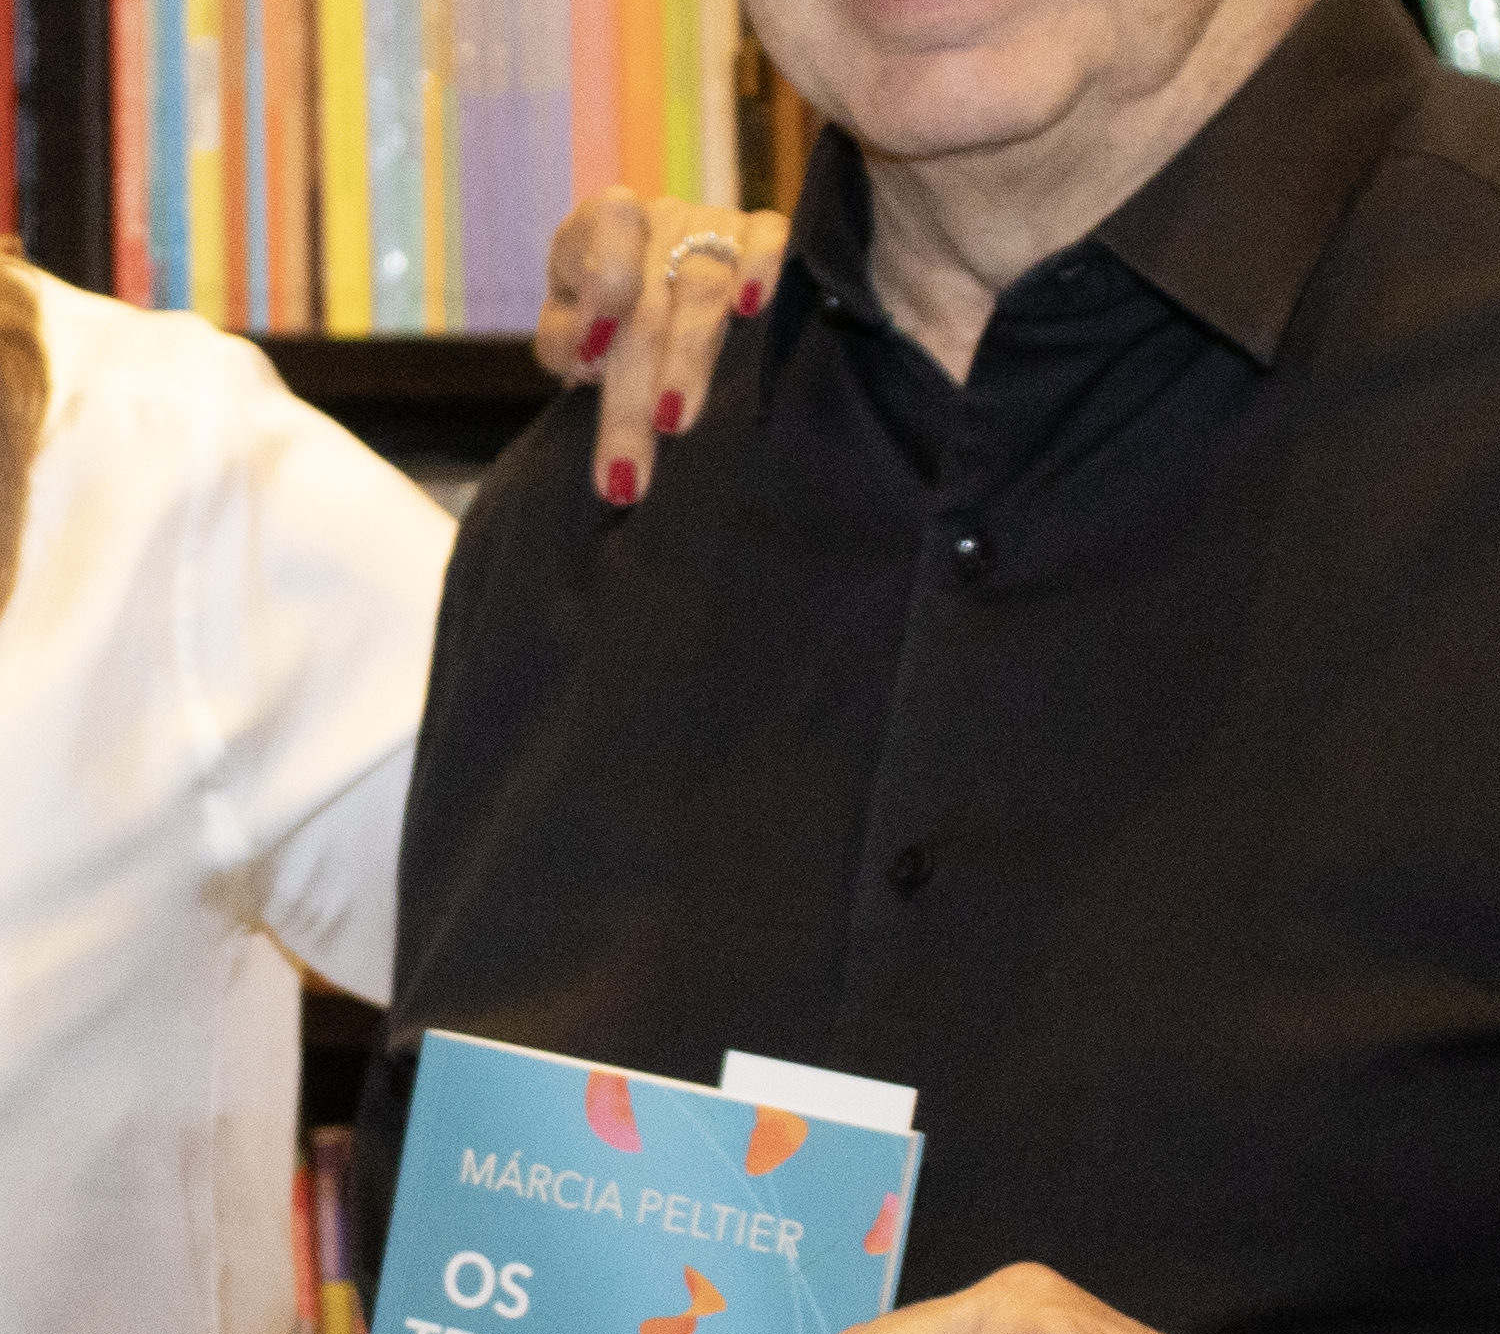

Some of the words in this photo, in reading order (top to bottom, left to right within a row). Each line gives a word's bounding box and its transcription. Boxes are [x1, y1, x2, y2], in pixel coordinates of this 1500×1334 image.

[459, 1148, 623, 1219] MÁRCIA
[636, 1188, 804, 1260] PELTIER
[443, 1250, 534, 1319] OS
